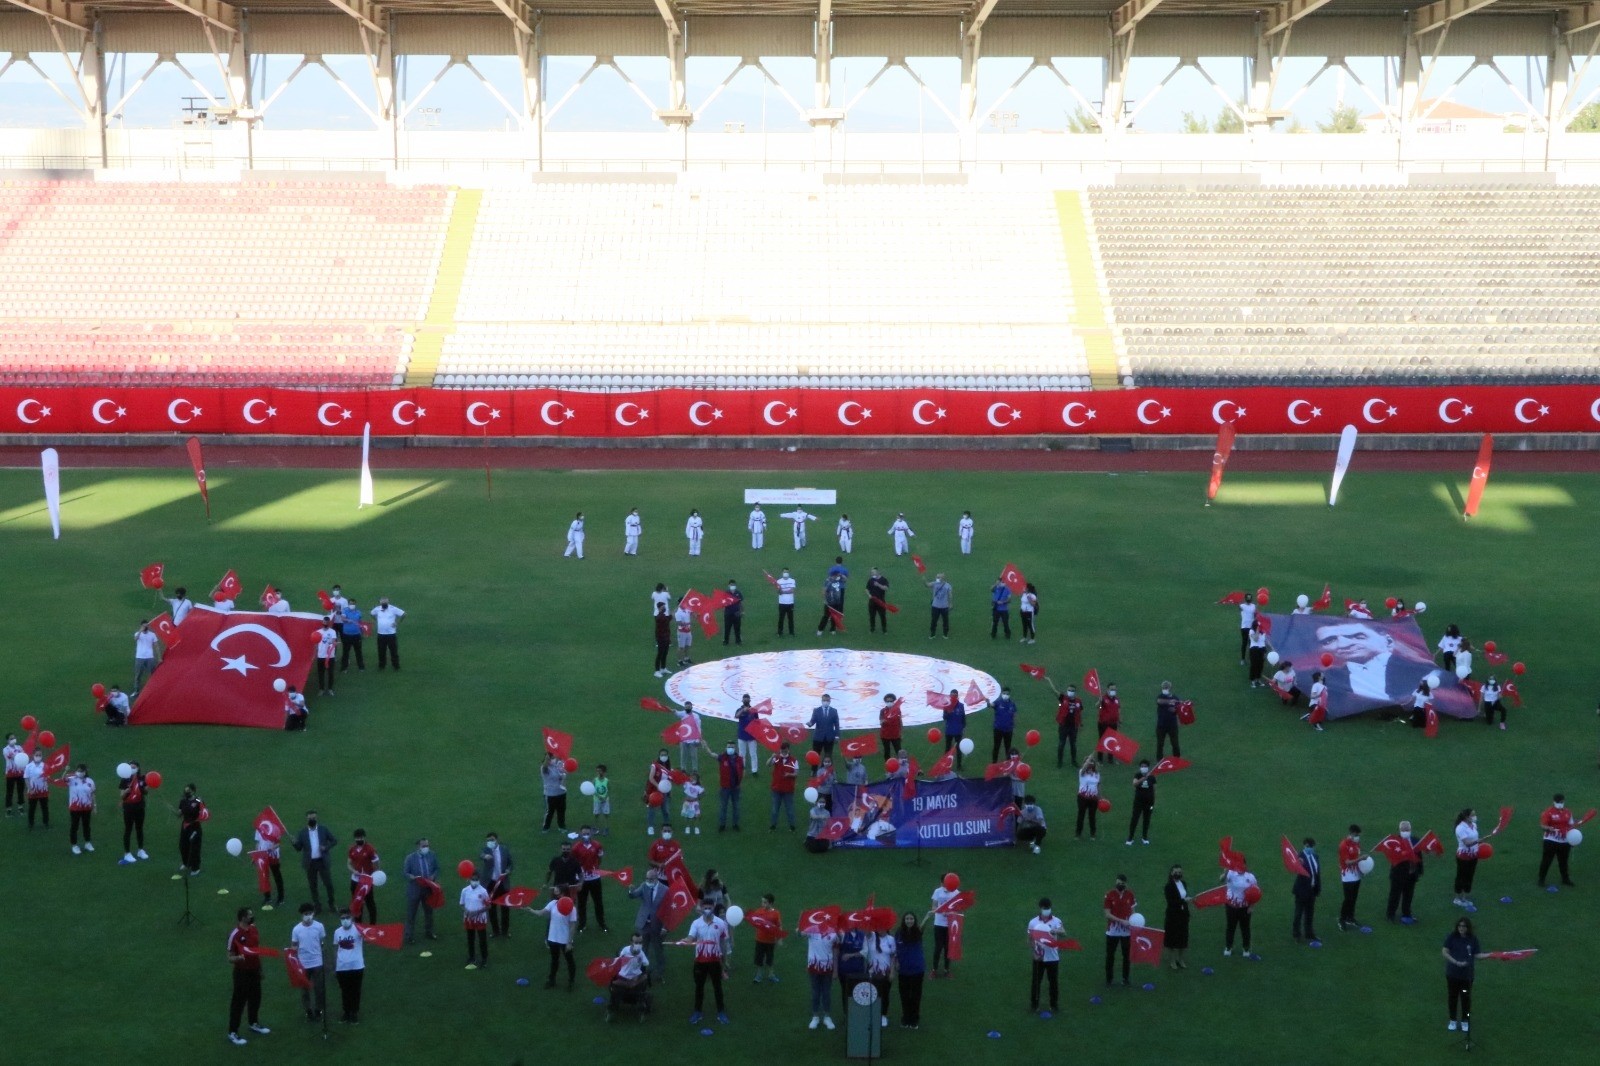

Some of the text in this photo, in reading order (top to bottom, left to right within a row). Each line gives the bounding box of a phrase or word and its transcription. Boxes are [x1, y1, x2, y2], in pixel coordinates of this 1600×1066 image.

[912, 793, 957, 812] 19 MAYIS
[953, 818, 991, 836] OLSUN!
